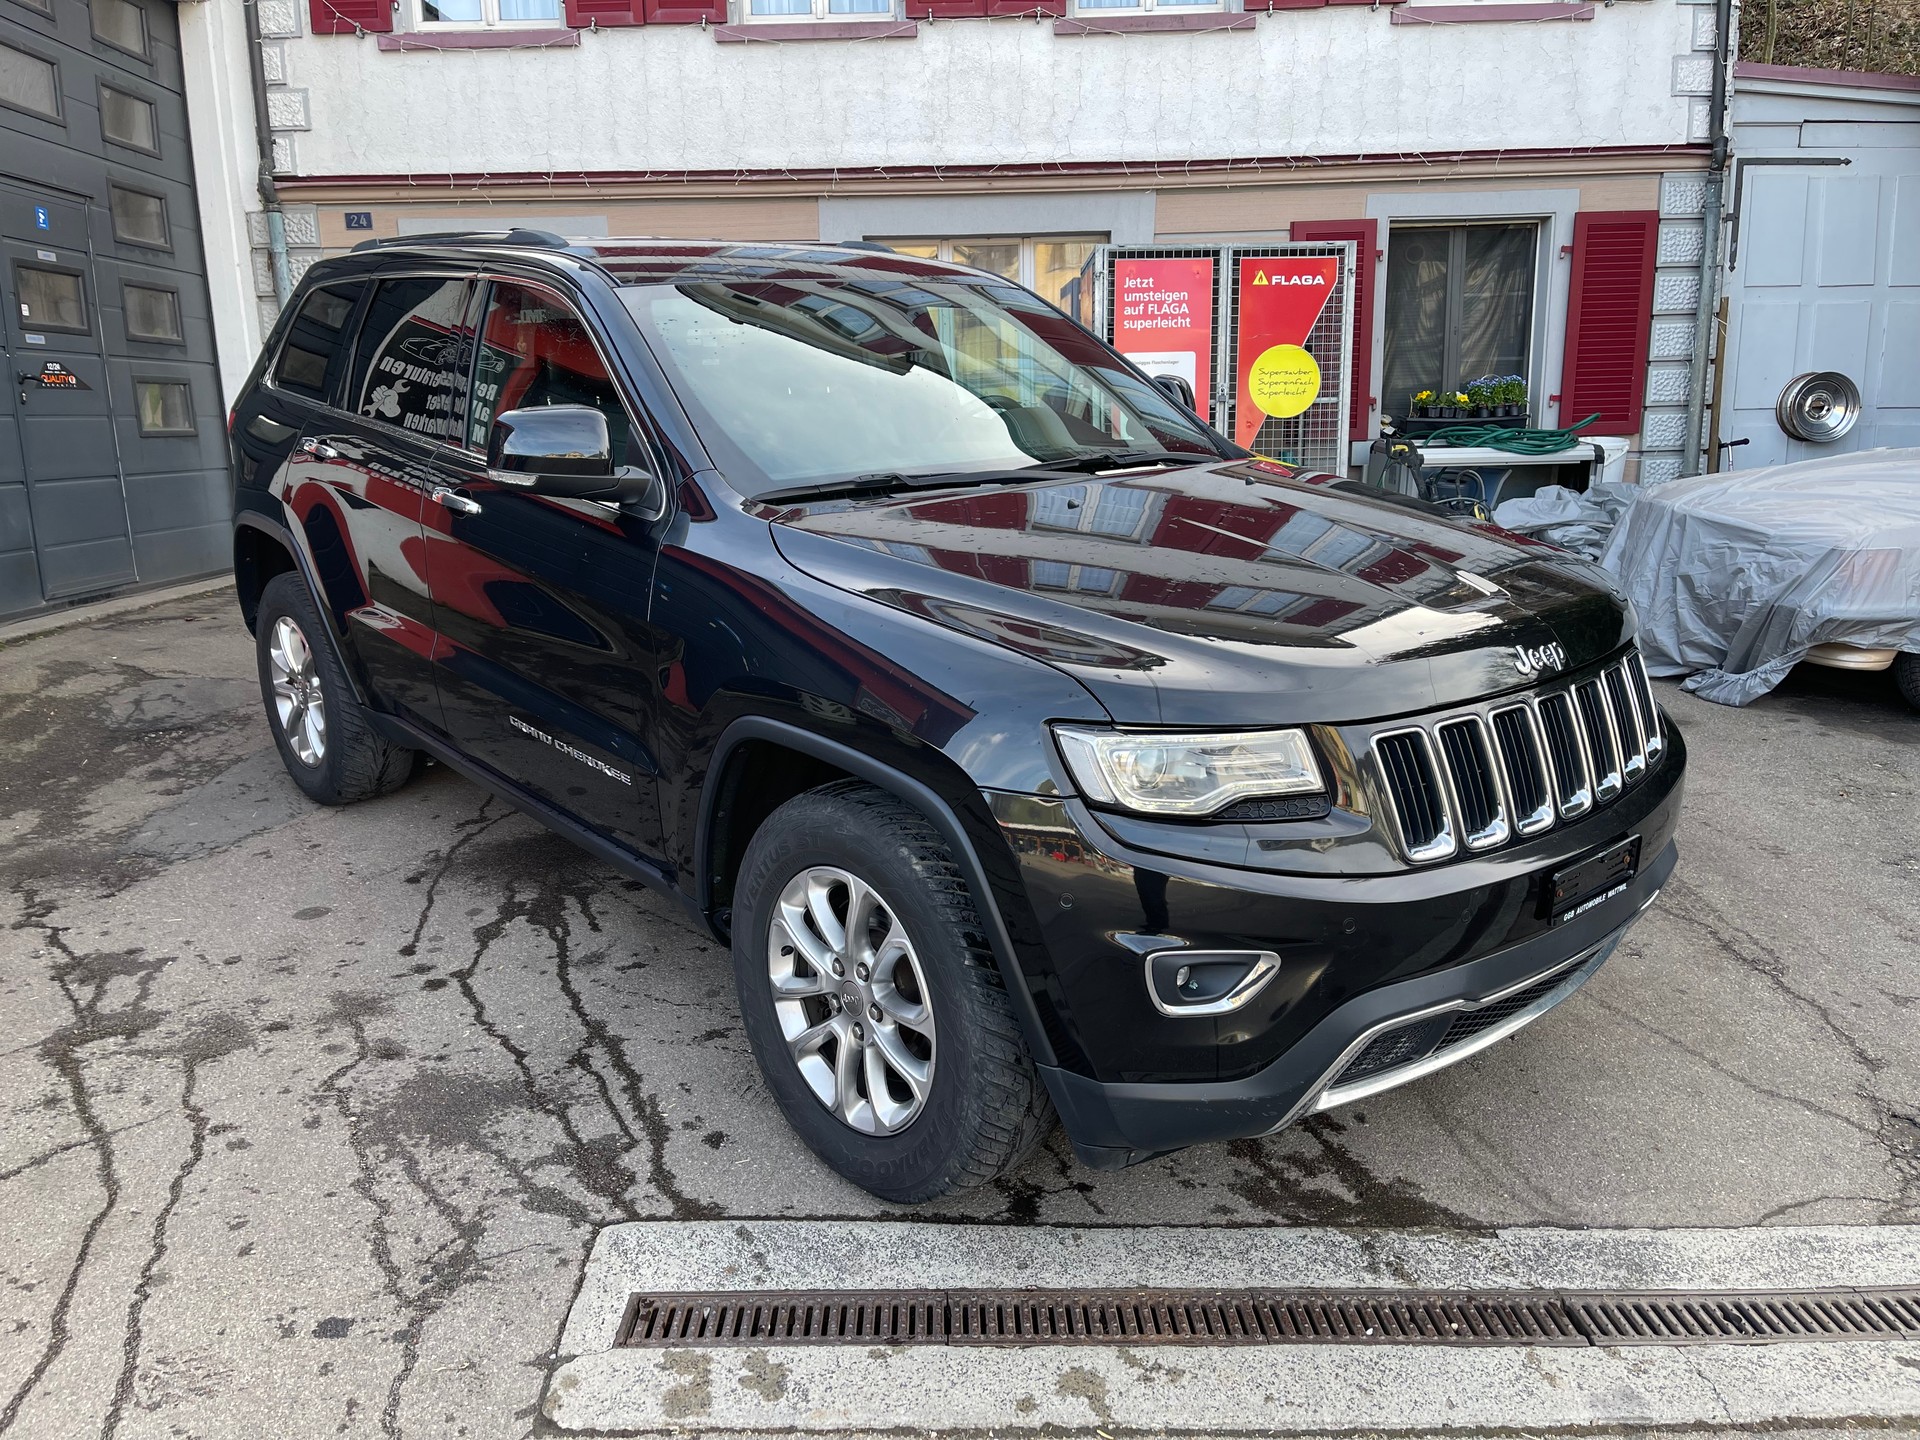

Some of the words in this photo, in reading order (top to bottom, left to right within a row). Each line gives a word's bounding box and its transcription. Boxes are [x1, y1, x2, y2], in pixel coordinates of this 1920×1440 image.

[350, 214, 368, 227] 24
[1123, 277, 1154, 288] Jetzt
[1271, 275, 1325, 286] FLAGA
[1124, 289, 1188, 304] umsteigen
[1123, 303, 1144, 316] auf
[1148, 303, 1189, 315] FLAGA
[1123, 316, 1191, 332] superleicht
[1258, 367, 1314, 378] Supersauber
[1258, 377, 1314, 389] Supereinfach
[1257, 387, 1307, 399] Superleicht
[1513, 641, 1566, 674] Jeep
[509, 715, 552, 745] GRAND
[553, 739, 632, 786] CHEROKEE
[1575, 893, 1606, 915] AUTOMOBILE
